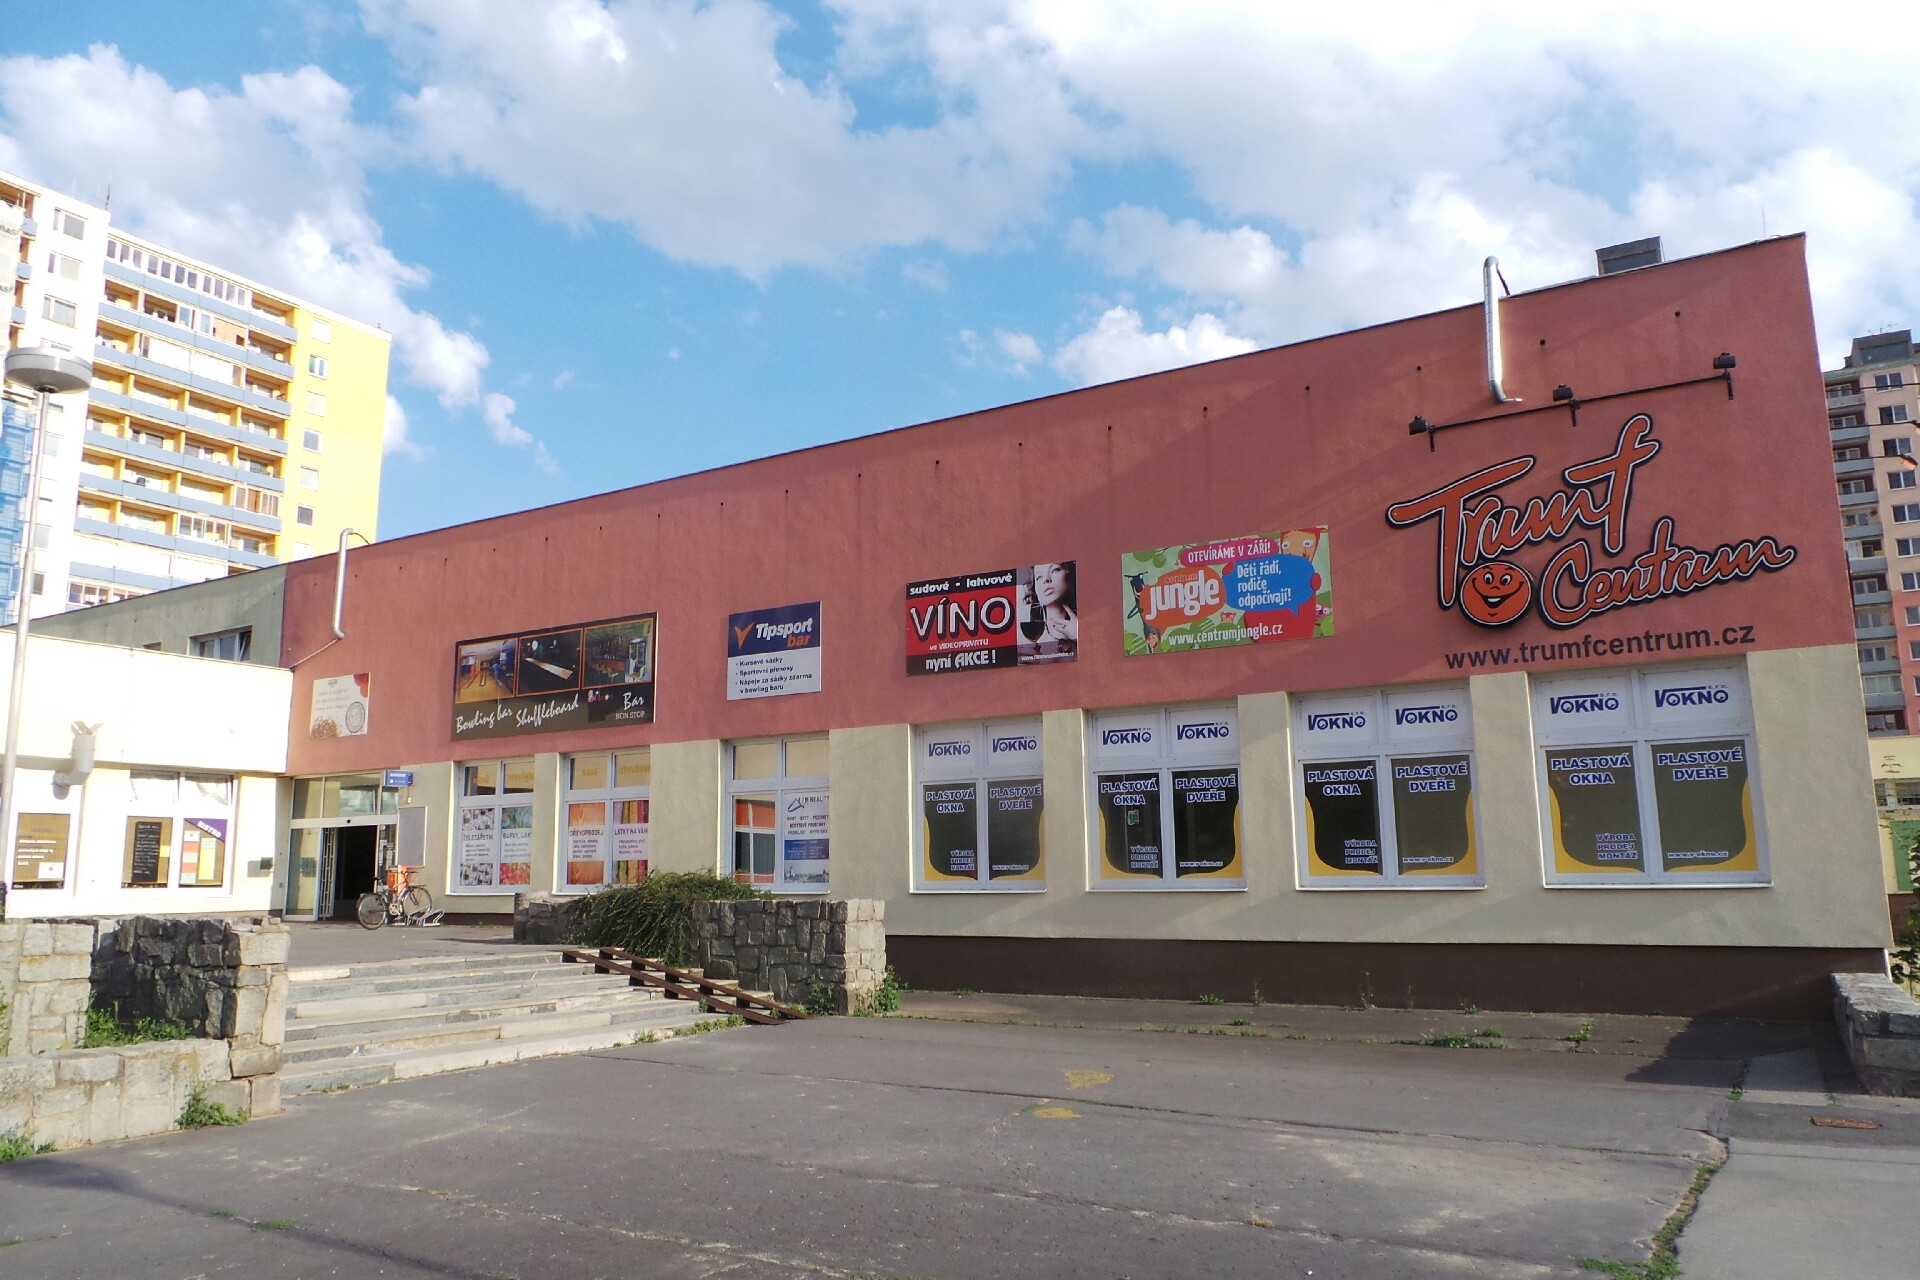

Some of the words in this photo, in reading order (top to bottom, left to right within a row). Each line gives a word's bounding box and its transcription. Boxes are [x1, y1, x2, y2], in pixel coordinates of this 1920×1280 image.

[1385, 413, 1662, 611] Trumf
[1188, 549, 1235, 564] OTEVÍRÁME
[1238, 546, 1244, 557] V
[1247, 541, 1271, 556] ZÁŘÍ!
[1237, 562, 1257, 578] Děti
[1259, 559, 1282, 576] řádí,
[1536, 516, 1798, 630] Centrum
[910, 581, 949, 595] sudové
[966, 573, 1013, 589] lahvové
[1164, 573, 1198, 584] centrum
[1238, 578, 1267, 593] rodiče
[1146, 569, 1220, 620] jungle
[1238, 588, 1292, 608] odpočívají!
[910, 597, 1013, 638] VÍNO
[756, 617, 813, 641] Tipsport
[1168, 623, 1283, 646] www.centrumjungle.cz
[787, 634, 811, 648] bar
[1445, 625, 1756, 670] www.trumfcentrum.cz
[765, 657, 783, 665] sázky
[925, 654, 952, 672] nyní
[789, 673, 813, 681] zdarma
[623, 692, 645, 711] Bar
[455, 710, 495, 734] Bowling
[497, 700, 513, 721] bar
[516, 693, 579, 728] Shuffleboard
[615, 711, 629, 720] NON
[630, 710, 645, 719] STOP
[1551, 753, 1631, 771] PLASTOVÁ
[1657, 748, 1743, 766] PLASTOVÉ
[1307, 766, 1375, 783] PLASTOVÁ
[1396, 762, 1468, 778] PLASTOVÉ
[1673, 766, 1729, 782] DVEŘE
[1101, 778, 1158, 794] PLASTOVÁ
[1175, 774, 1236, 790] PLASTOVÉ
[1409, 778, 1456, 793] DVEŘE
[1569, 772, 1615, 786] OKNA
[925, 788, 976, 801] PLASTOVÁ
[990, 784, 1042, 798] PLASTOVÉ
[1187, 789, 1226, 804] DVEŘE
[1322, 784, 1361, 797] OKNA
[936, 803, 965, 813] OKNA
[999, 798, 1033, 811] DVEŘE
[1113, 795, 1146, 806] OKNA
[197, 820, 222, 838] BISTRO
[1344, 838, 1377, 848] VÝROBA
[1597, 833, 1636, 842] VÝROBA
[1344, 848, 1376, 856] PRODEJ
[1597, 842, 1635, 851] PRODEJ
[1667, 851, 1729, 859] www.v-okno.cz
